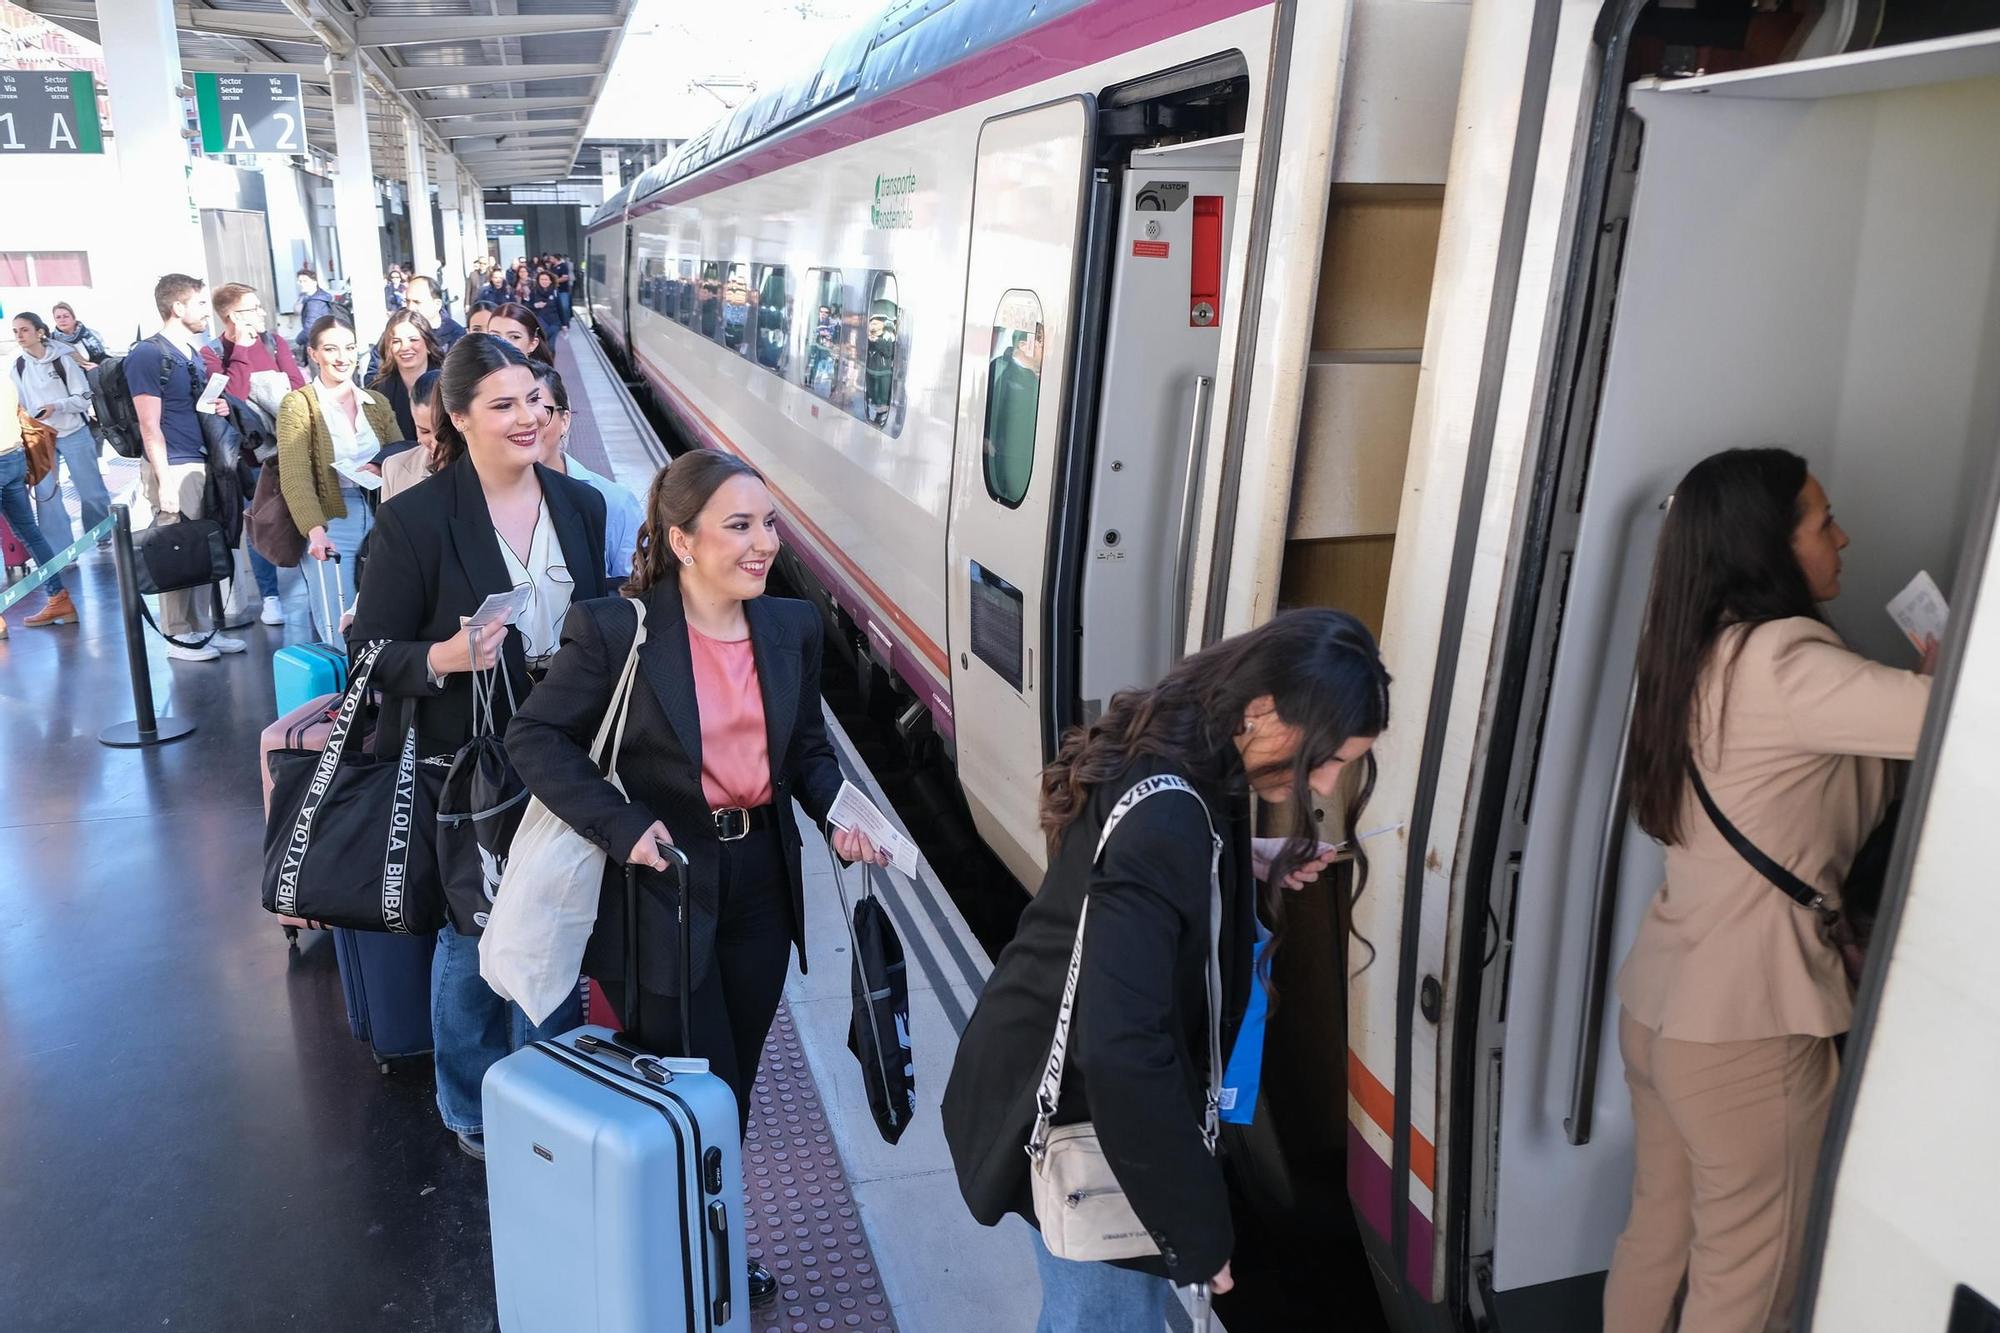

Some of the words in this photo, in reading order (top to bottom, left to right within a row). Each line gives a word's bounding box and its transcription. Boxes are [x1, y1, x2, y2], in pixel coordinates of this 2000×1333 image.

[44, 85, 69, 93] Sector
[0, 112, 26, 149] 1
[49, 112, 77, 149] A
[227, 113, 255, 149] A
[272, 112, 297, 149] 2
[881, 168, 916, 202] transporte
[311, 740, 342, 795] BIMBA
[340, 676, 366, 722] LOLA
[291, 806, 314, 854] LOLA
[390, 803, 410, 851] LOLA
